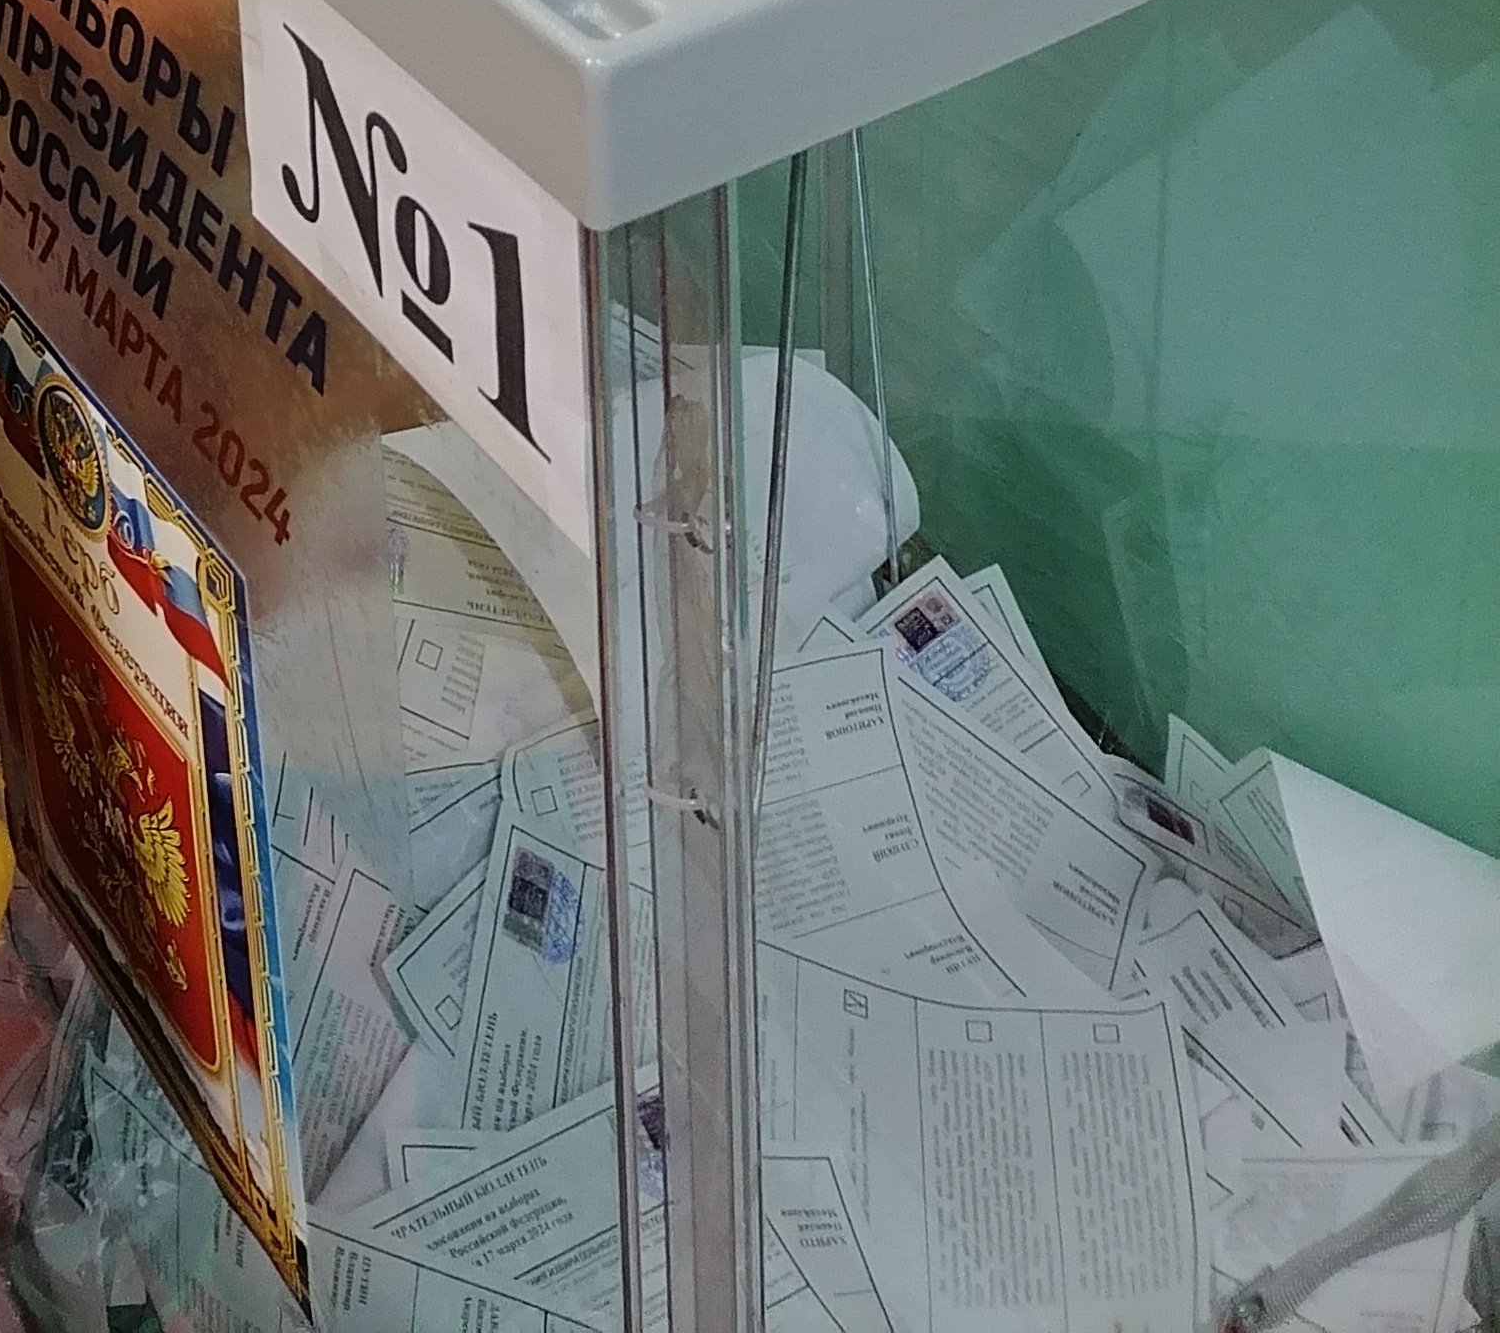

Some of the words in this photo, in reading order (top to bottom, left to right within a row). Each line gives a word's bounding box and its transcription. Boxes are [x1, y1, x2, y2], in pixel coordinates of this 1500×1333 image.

[64, 251, 185, 428] МАРТА
[192, 401, 294, 548] 2024
[38, 482, 120, 615] Герб
